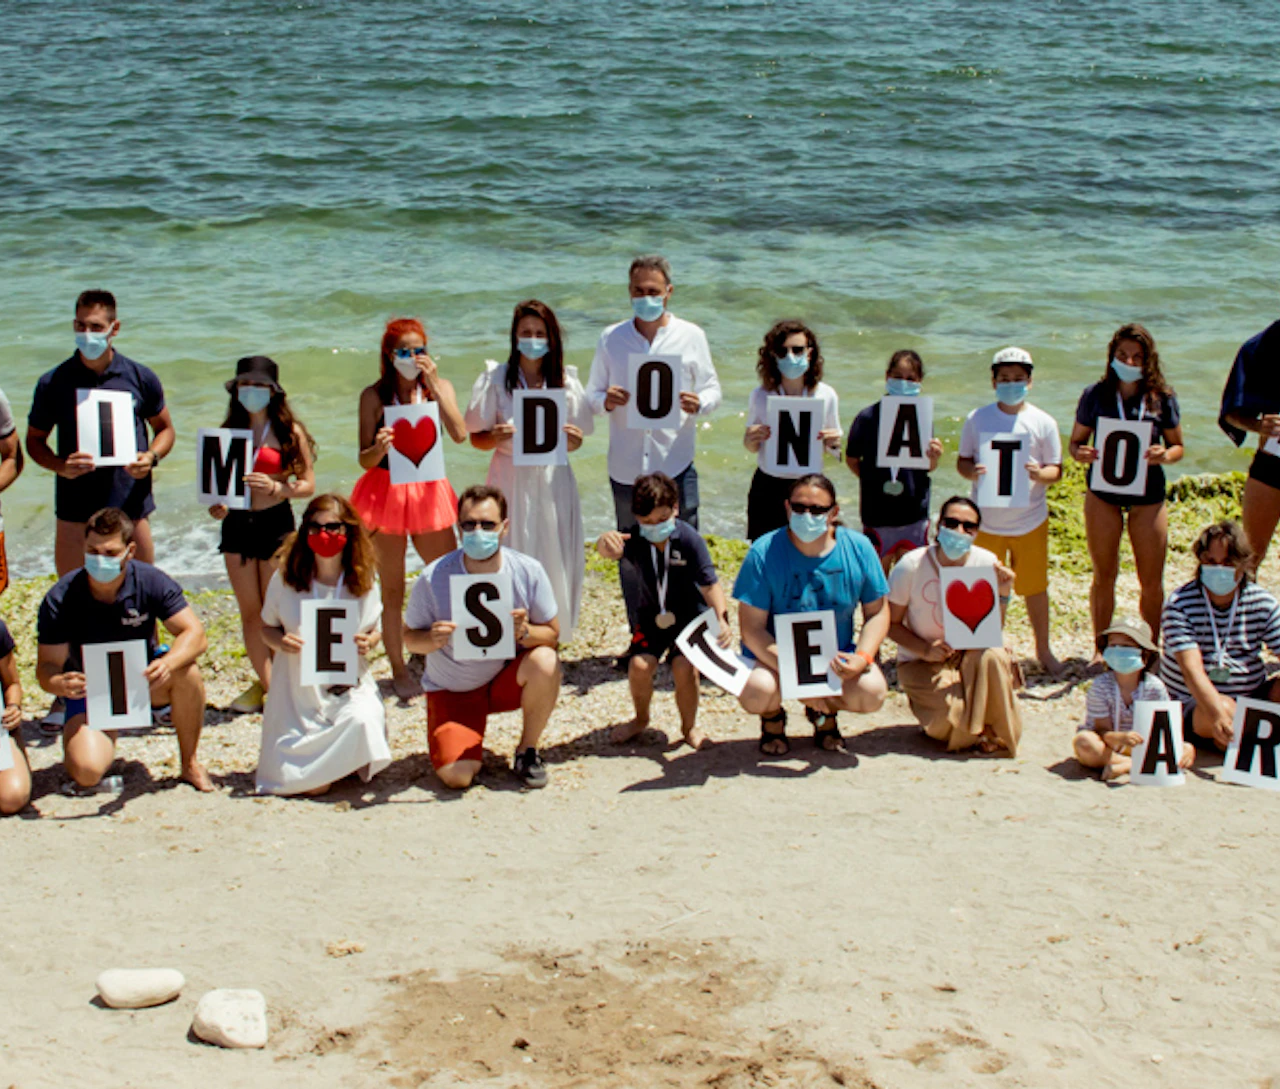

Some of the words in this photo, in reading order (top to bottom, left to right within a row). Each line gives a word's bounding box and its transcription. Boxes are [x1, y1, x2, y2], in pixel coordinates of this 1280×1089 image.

[636, 361, 673, 419] O
[522, 397, 558, 454] D
[776, 410, 812, 467] N
[886, 404, 922, 458] A
[201, 436, 247, 497] M
[992, 440, 1022, 496] T
[1101, 430, 1140, 487] O
[316, 608, 346, 672] E
[686, 620, 738, 677] T
[792, 621, 828, 685] E
[1141, 711, 1178, 775] A
